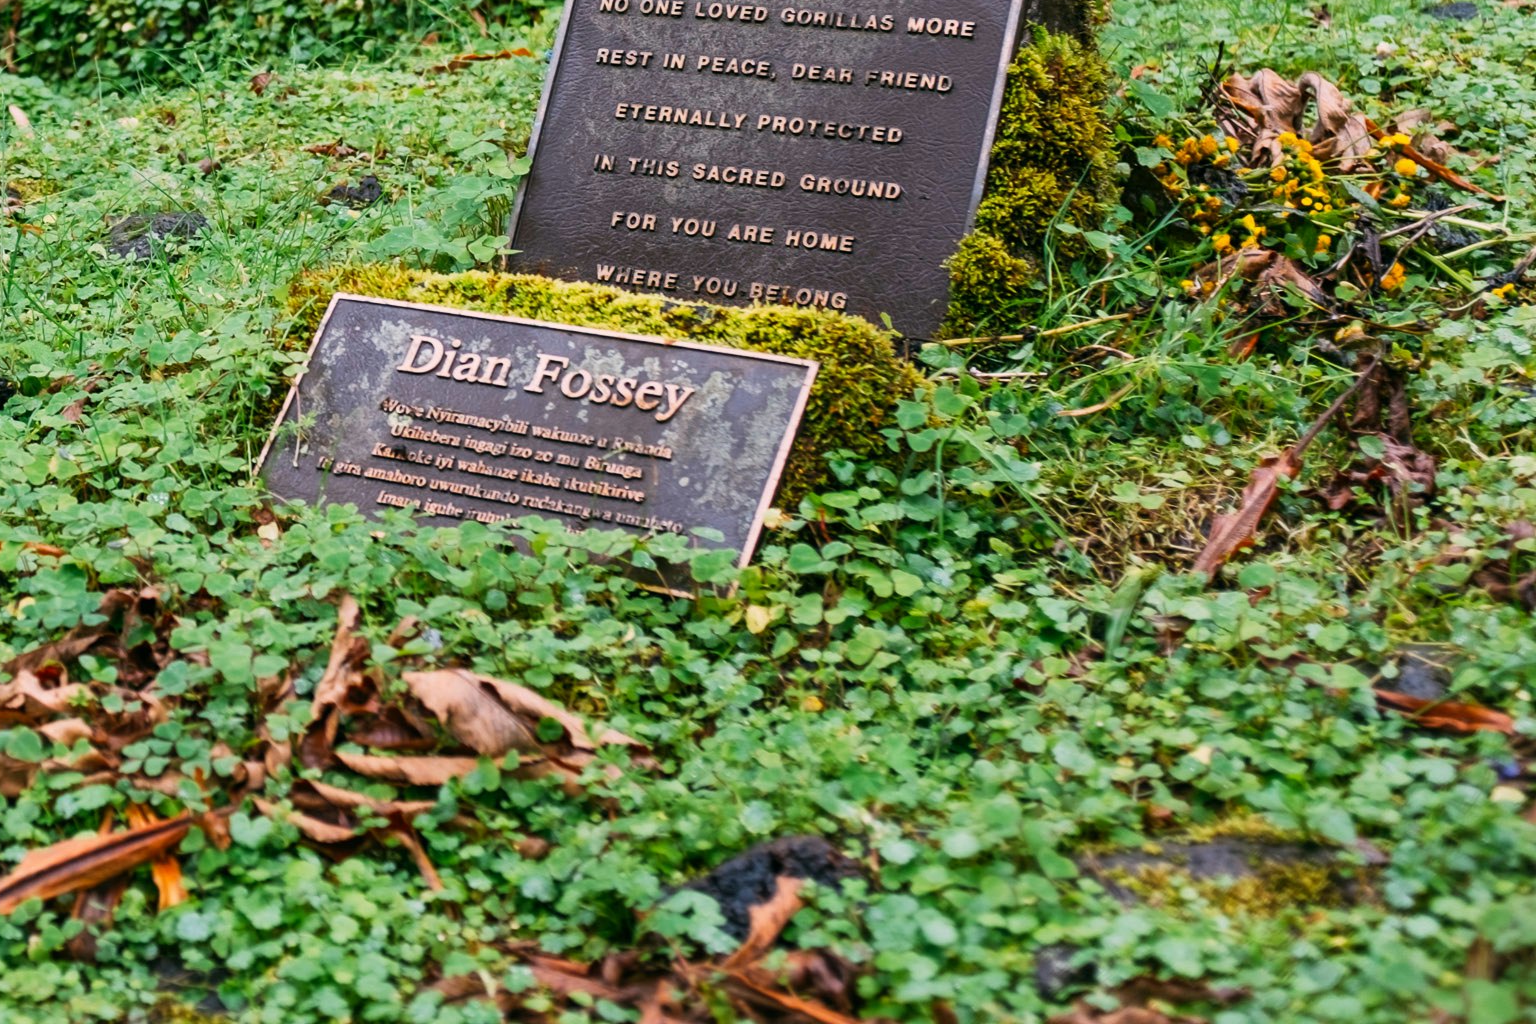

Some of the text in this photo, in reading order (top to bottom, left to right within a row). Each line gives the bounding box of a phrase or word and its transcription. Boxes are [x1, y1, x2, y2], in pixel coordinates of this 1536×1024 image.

[695, 1, 768, 23] LOVED
[780, 7, 894, 32] GORILLAS
[907, 16, 976, 38] MORE
[596, 48, 954, 92] REST IN PEACE, DEAR FRIEND
[615, 103, 903, 144] ETERNALLY PROTECTED
[593, 154, 902, 200] IN THIS SACRED GROUND
[610, 211, 855, 253] FOR YOU ARE HOME
[596, 264, 848, 310] WHERE YOU BELONG
[397, 335, 695, 423] Dian Fossey
[435, 454, 454, 469] iyi
[520, 469, 560, 488] ikaba
[465, 436, 507, 455] ingagi
[510, 443, 532, 458] izo
[535, 450, 553, 462] zo
[557, 454, 580, 466] mu
[364, 467, 426, 487] amahoro
